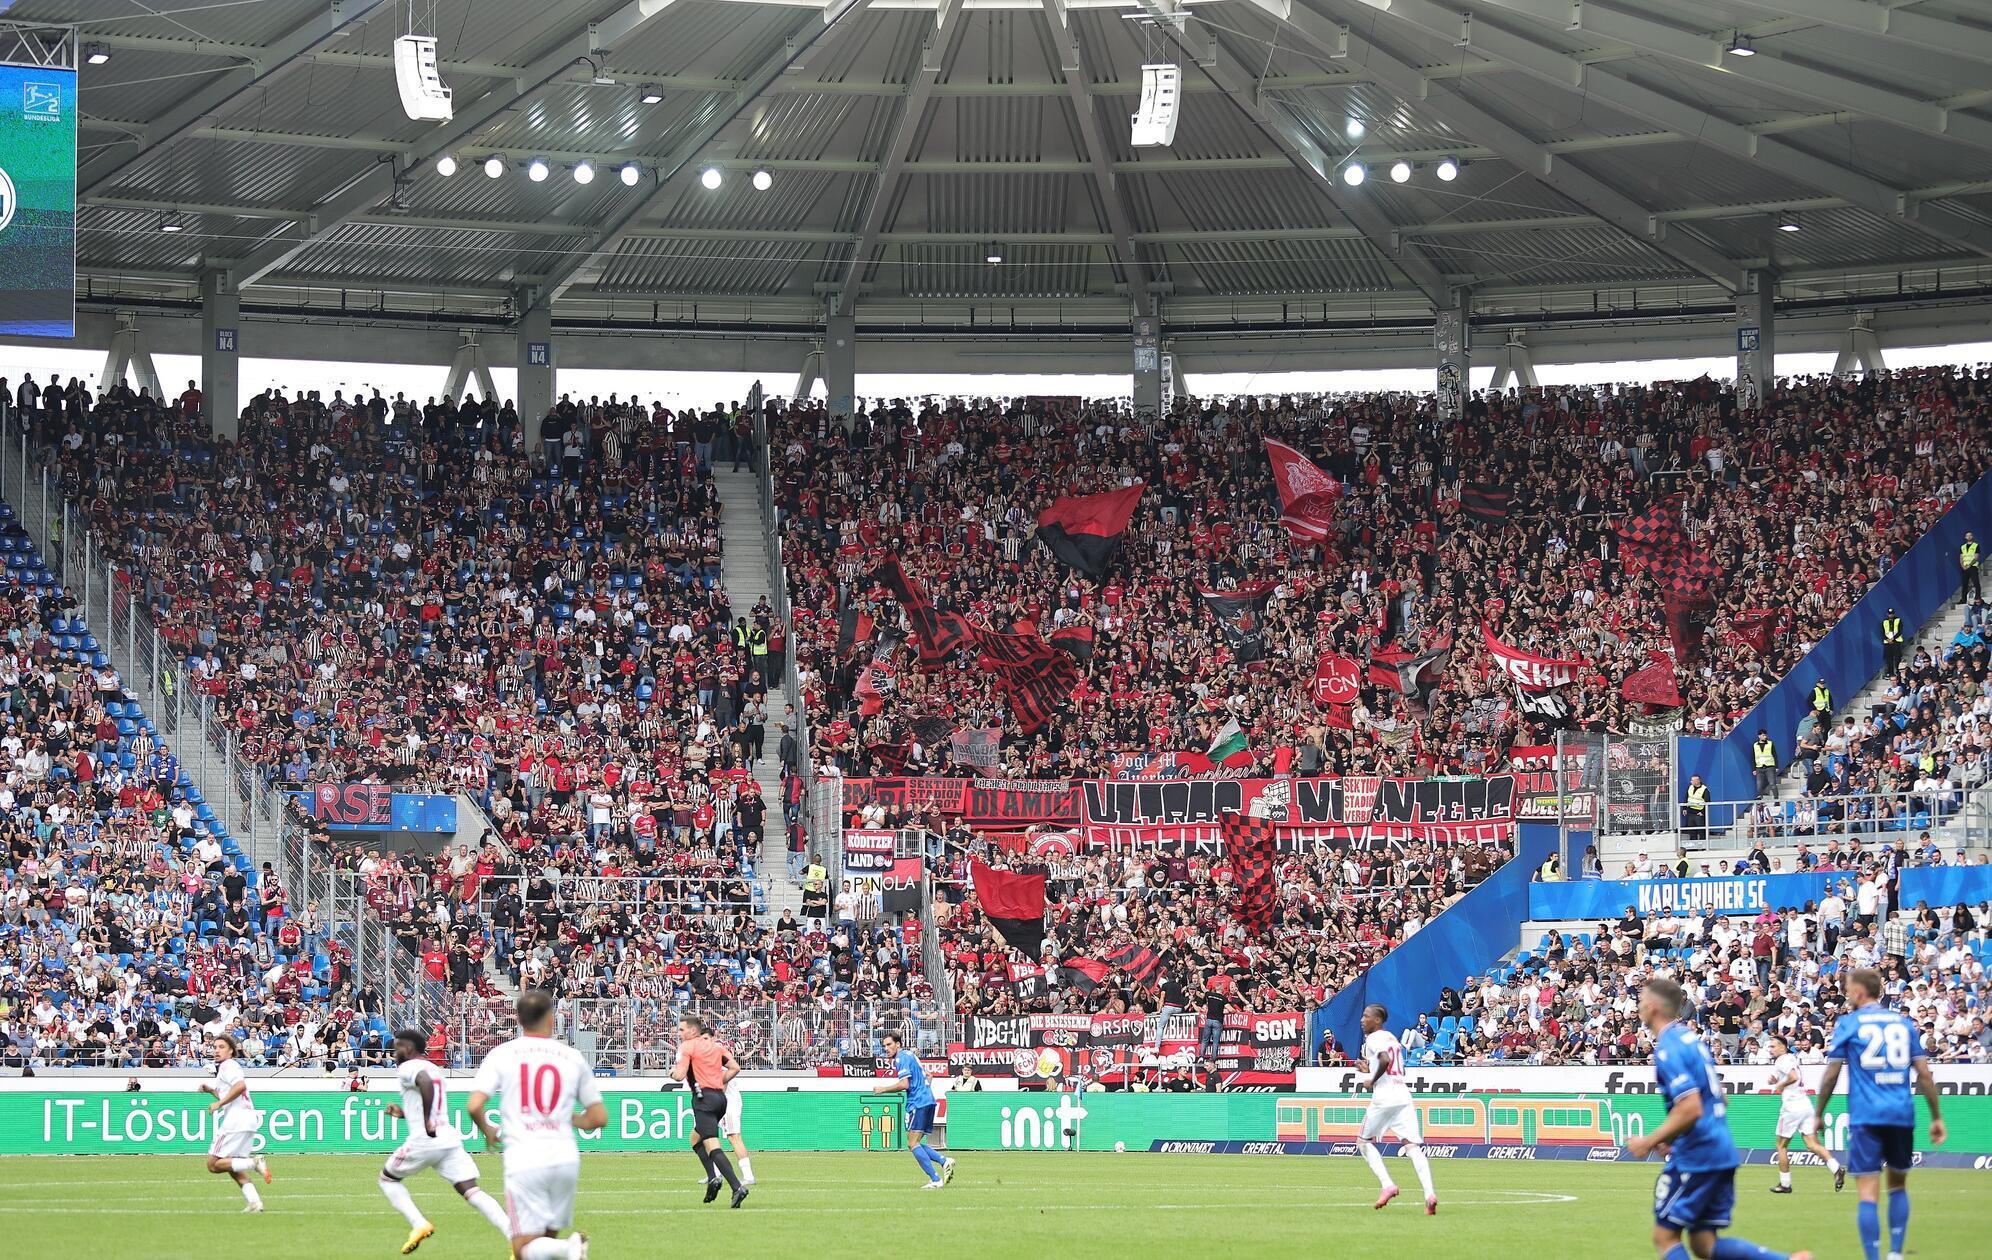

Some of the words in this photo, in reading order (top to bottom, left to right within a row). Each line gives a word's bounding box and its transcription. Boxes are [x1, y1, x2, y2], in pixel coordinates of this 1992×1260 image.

[23, 114, 60, 122] BUNDESLIGA
[219, 337, 233, 350] N4
[531, 351, 545, 364] N4
[1327, 661, 1340, 677] 1.
[1318, 674, 1358, 696] FCN
[909, 779, 963, 790] SEKTION
[909, 789, 963, 800] STADION
[315, 784, 391, 823] RSE
[971, 790, 999, 817] DI
[1002, 790, 1081, 818] AMICI
[1083, 781, 1243, 826] ULTRAS
[847, 832, 893, 849] KÖDITZER
[847, 853, 874, 868] LAND
[1638, 880, 1745, 912] KARLSRUHER
[1748, 879, 1767, 908] SC
[1018, 977, 1036, 998] LW
[1030, 1015, 1044, 1029] DIE
[1101, 1018, 1130, 1036] RSR
[1255, 1018, 1298, 1042] SGN
[973, 1015, 1031, 1049] NBG-LW
[1856, 1023, 1912, 1069] 28
[950, 1051, 1014, 1066] SEENLAND
[520, 1062, 562, 1115] 10
[1000, 1094, 1089, 1149] init
[1168, 1142, 1216, 1154] CRONIMET
[1241, 1142, 1286, 1154] CREMETAL
[1487, 1146, 1537, 1160] CREMETAL
[1769, 1151, 1826, 1166] CEMETAL
